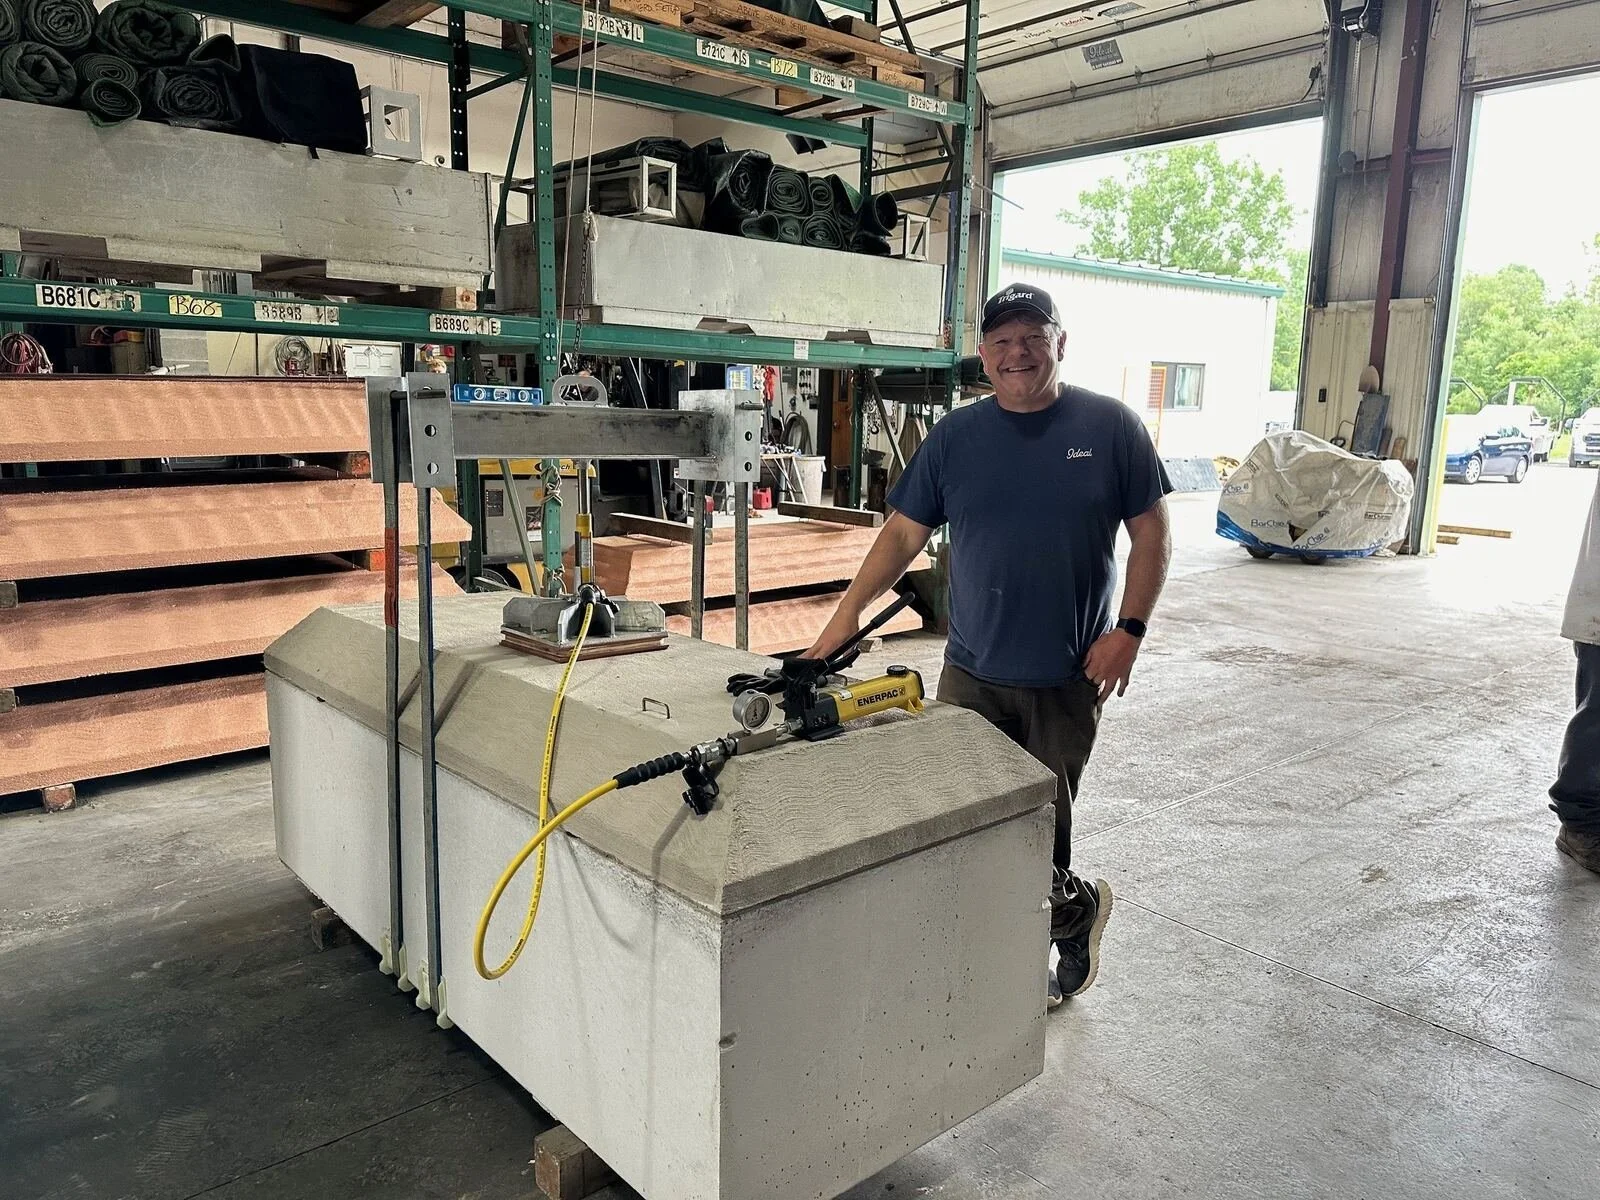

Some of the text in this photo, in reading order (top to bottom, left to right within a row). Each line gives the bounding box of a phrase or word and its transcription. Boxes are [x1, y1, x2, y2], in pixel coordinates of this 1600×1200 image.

[41, 285, 100, 308] B681C
[435, 317, 497, 333] B689C E
[1066, 447, 1093, 460] Ideal
[1251, 519, 1285, 528] BarChip
[857, 689, 898, 707] ENERPAC
